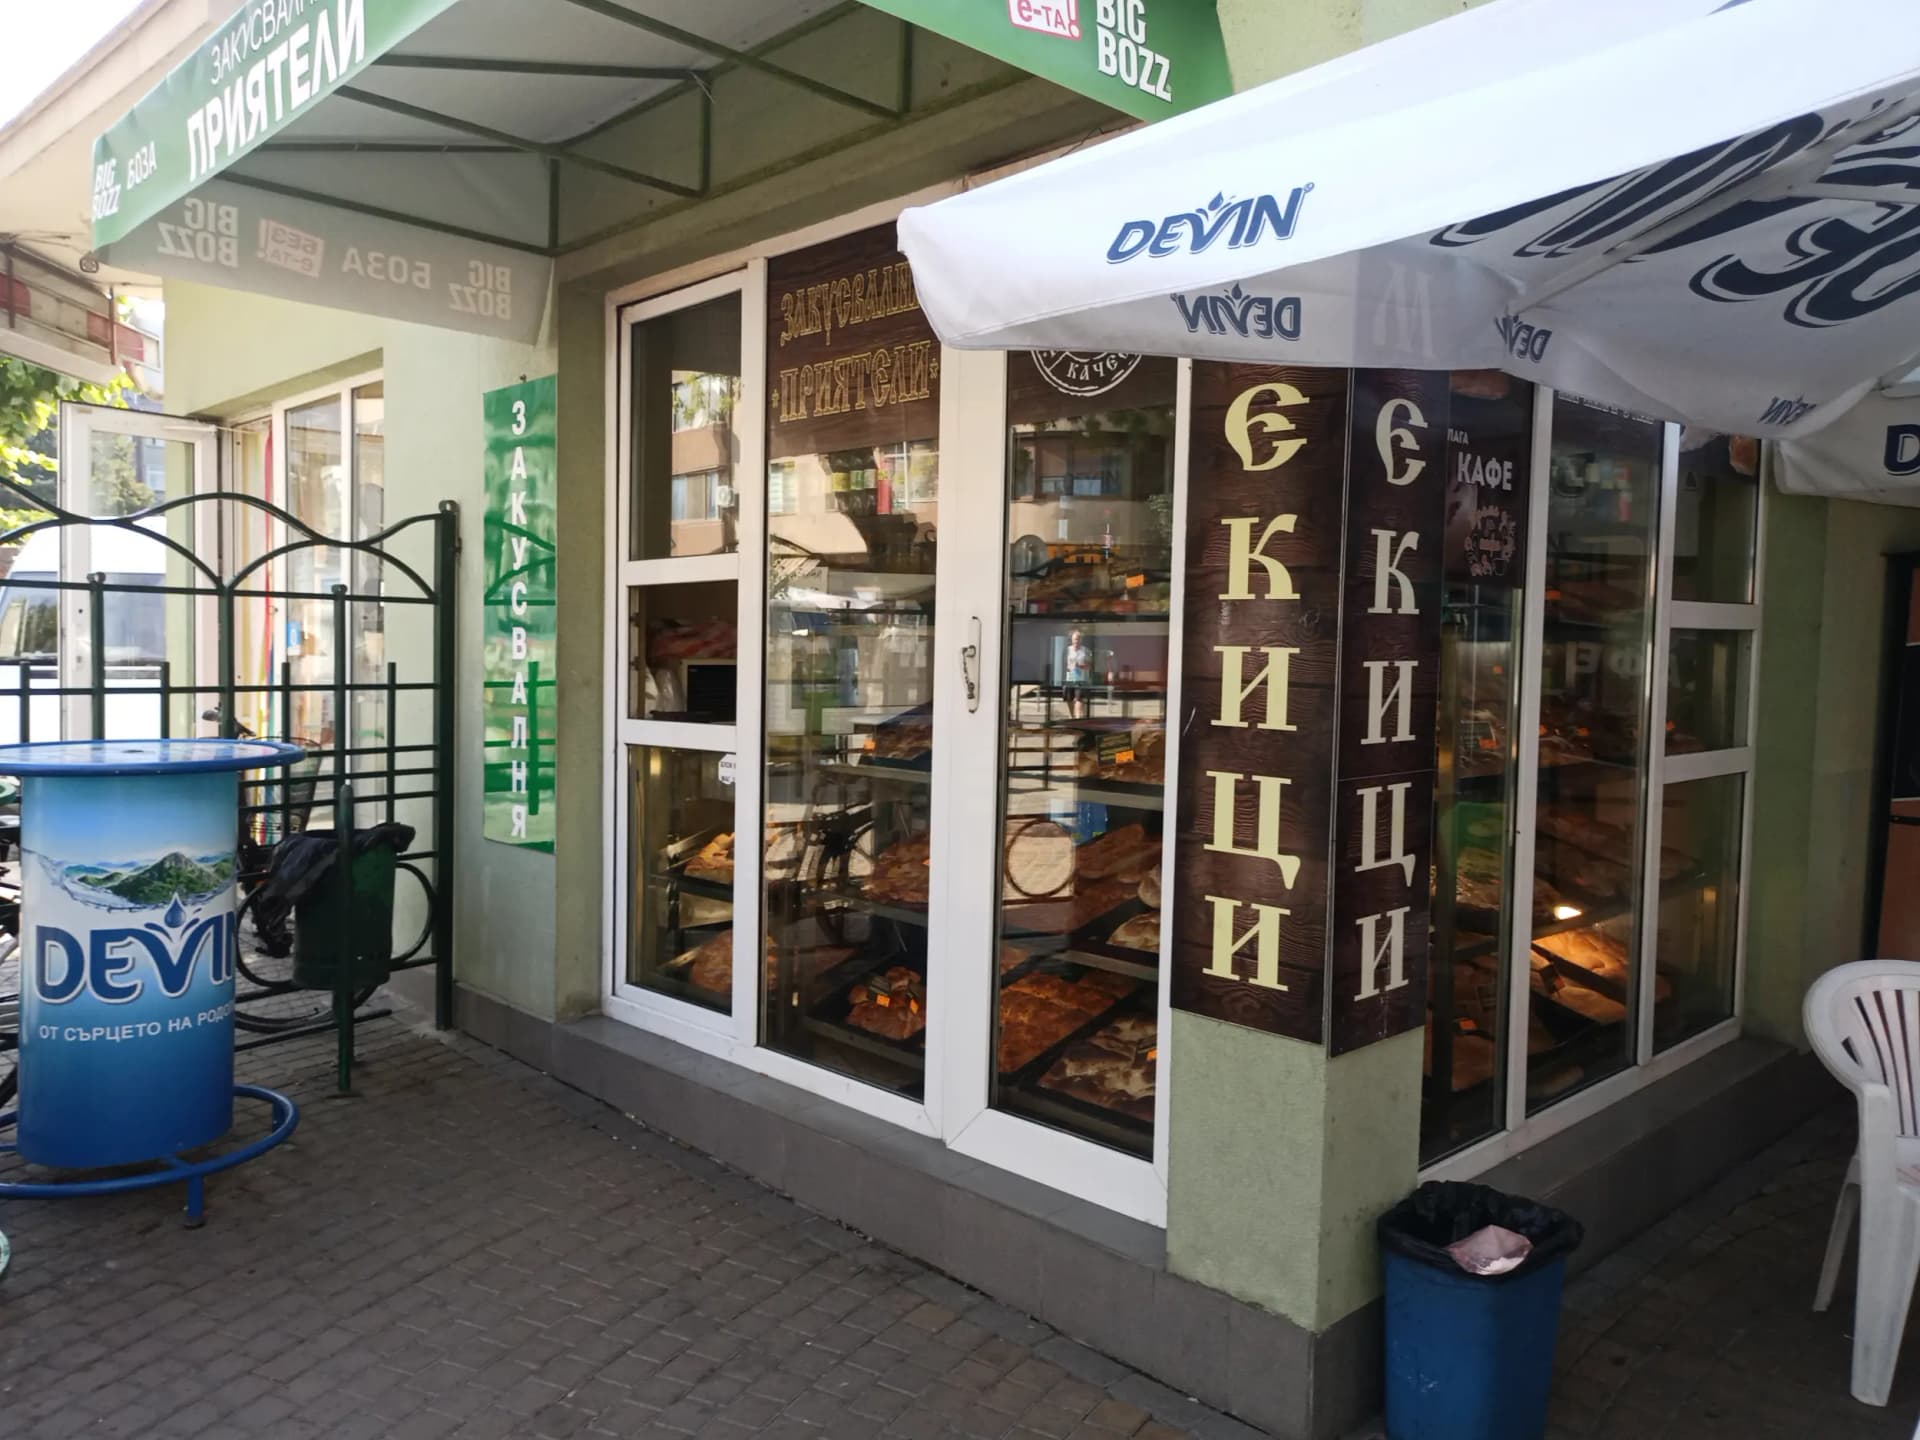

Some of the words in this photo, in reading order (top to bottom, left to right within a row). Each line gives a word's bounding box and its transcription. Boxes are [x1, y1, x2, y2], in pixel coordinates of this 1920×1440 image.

[210, 0, 317, 84] ЗАКУСВАЛ
[1096, 0, 1147, 44] BIG
[186, 0, 365, 182] ПРИЯТЕЛИ
[1096, 26, 1172, 102] BOZZ
[95, 158, 117, 194] BIG
[127, 141, 158, 190] БОЗА
[1106, 187, 1305, 264] DEVIN
[779, 340, 932, 423] ПРИЯТЕЛИ
[1457, 451, 1513, 491] КАФЕ
[511, 400, 527, 838] ЗАКУСВАЛНЯ
[36, 911, 236, 1003] DEVI
[39, 1026, 58, 1039] ОТ
[64, 1021, 161, 1043] СЪРЦЕТО
[168, 1016, 192, 1032] НА
[197, 1003, 234, 1026] РОДО
